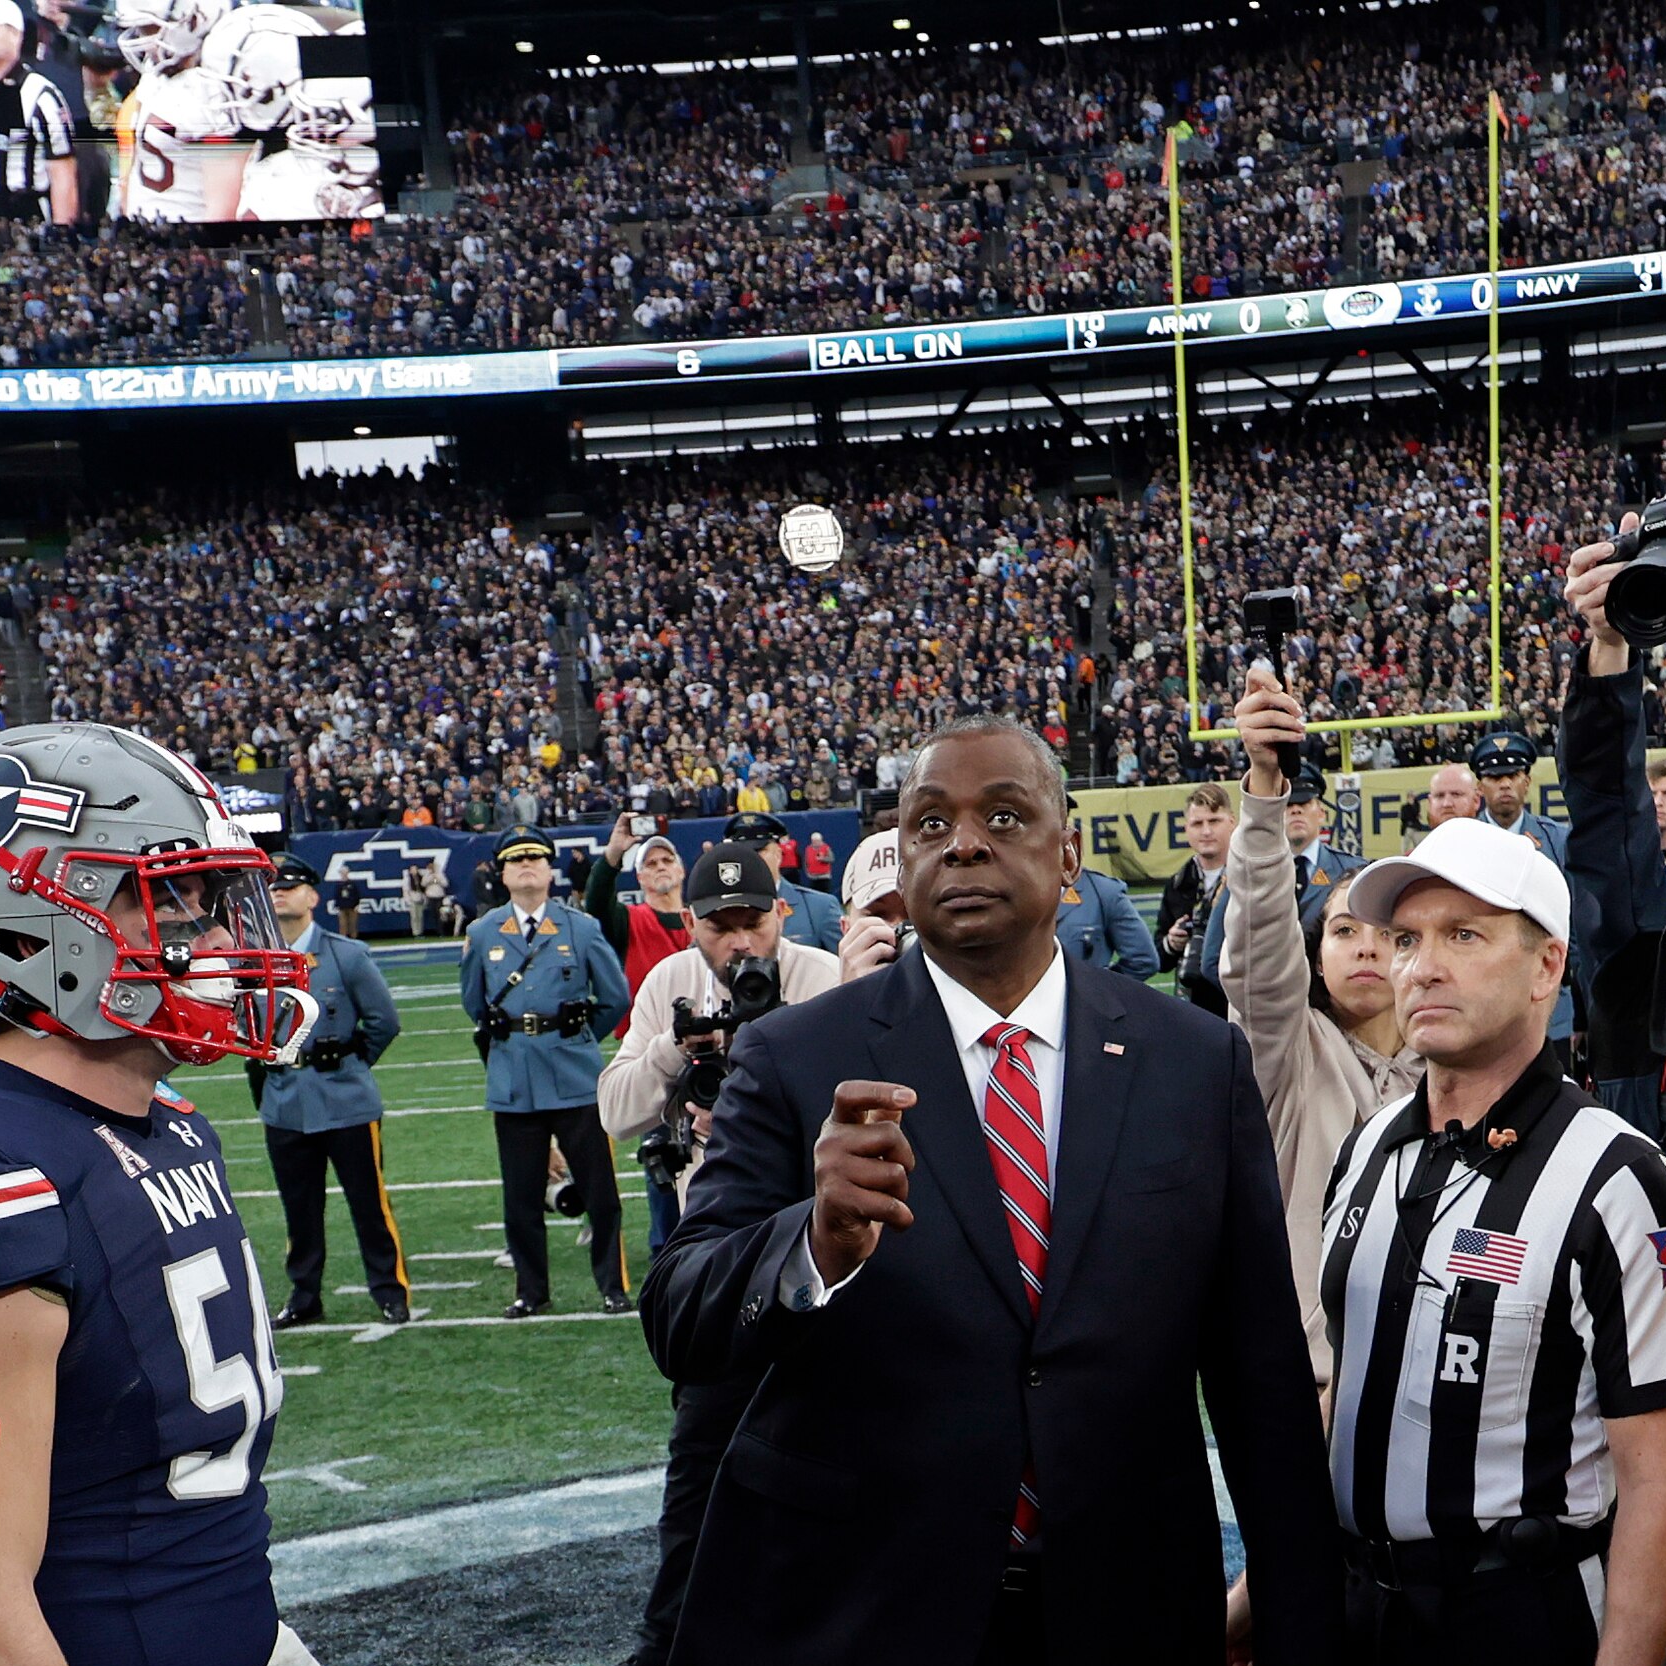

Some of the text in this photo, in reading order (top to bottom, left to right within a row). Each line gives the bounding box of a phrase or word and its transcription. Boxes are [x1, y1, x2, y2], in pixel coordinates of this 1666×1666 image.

[1471, 278, 1493, 310] 0
[1516, 273, 1580, 298] NAVY
[1639, 272, 1653, 292] 3
[1146, 312, 1212, 336] ARMY
[1238, 302, 1261, 334] 0
[818, 331, 964, 368] BALL ON
[1083, 331, 1097, 349] 3
[23, 369, 82, 402] the
[85, 366, 184, 401] 122nd
[191, 361, 377, 402] Army-Navy
[381, 359, 474, 390] Game
[140, 1160, 232, 1235] NAVY
[1439, 1332, 1480, 1384] R
